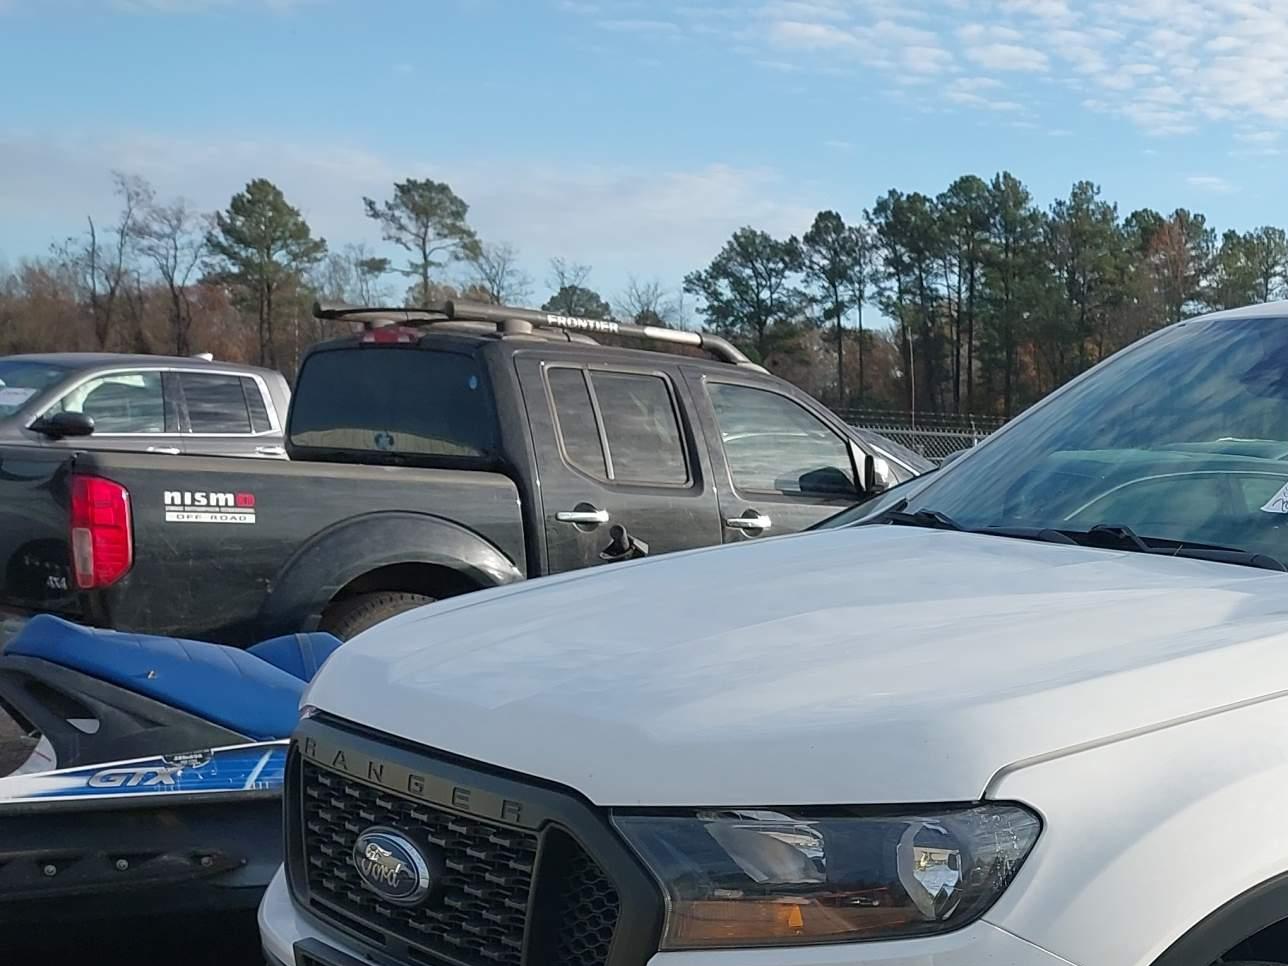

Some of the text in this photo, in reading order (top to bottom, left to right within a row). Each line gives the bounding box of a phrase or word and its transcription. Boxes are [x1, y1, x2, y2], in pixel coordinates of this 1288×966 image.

[547, 314, 619, 333] FRONTIER
[164, 490, 255, 507] nismo
[88, 766, 178, 788] GTX
[304, 736, 523, 823] RANGER
[361, 842, 401, 889] Ford
